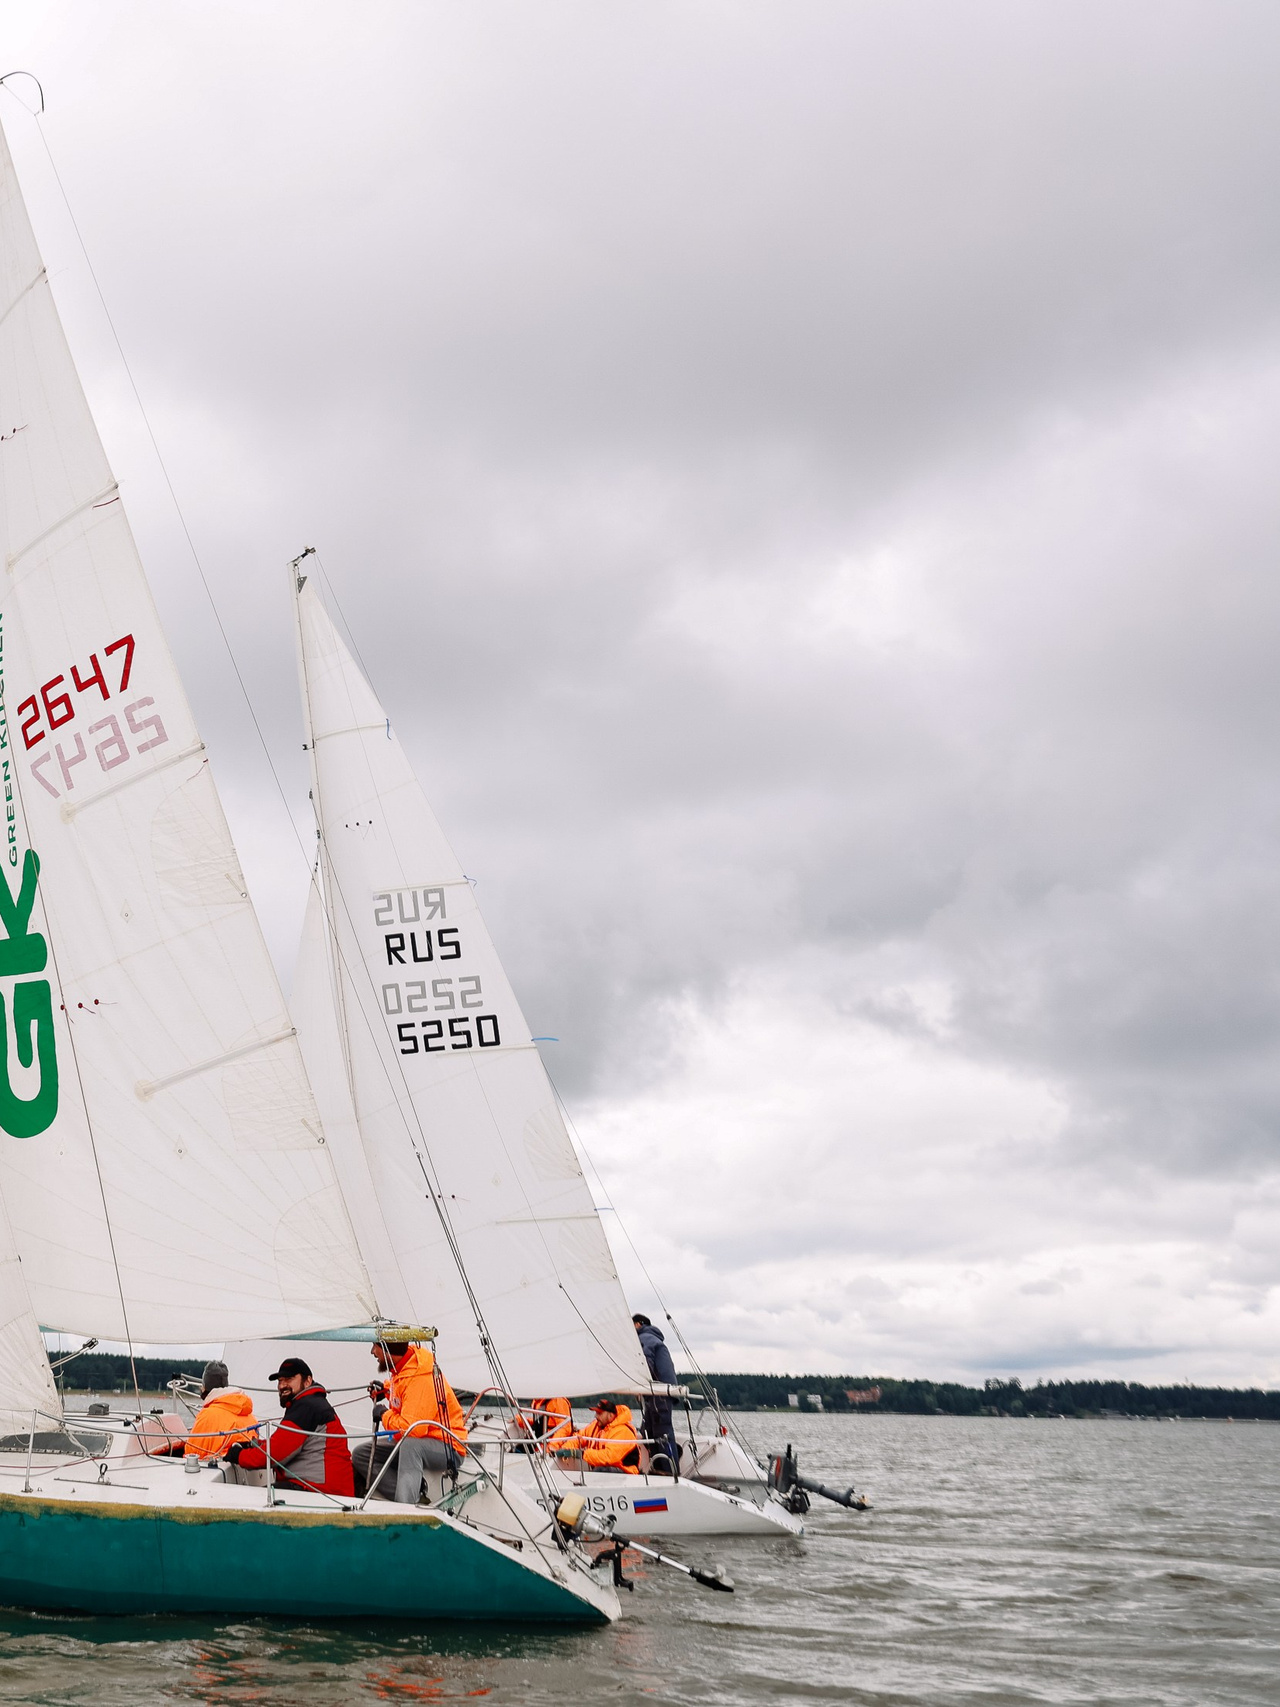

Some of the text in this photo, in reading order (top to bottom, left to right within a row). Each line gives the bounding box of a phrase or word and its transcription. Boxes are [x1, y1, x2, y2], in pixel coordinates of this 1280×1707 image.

[17, 634, 135, 751] 2647
[1, 760, 18, 867] GREEN
[385, 927, 461, 965] RUS
[397, 1014, 500, 1054] 5250
